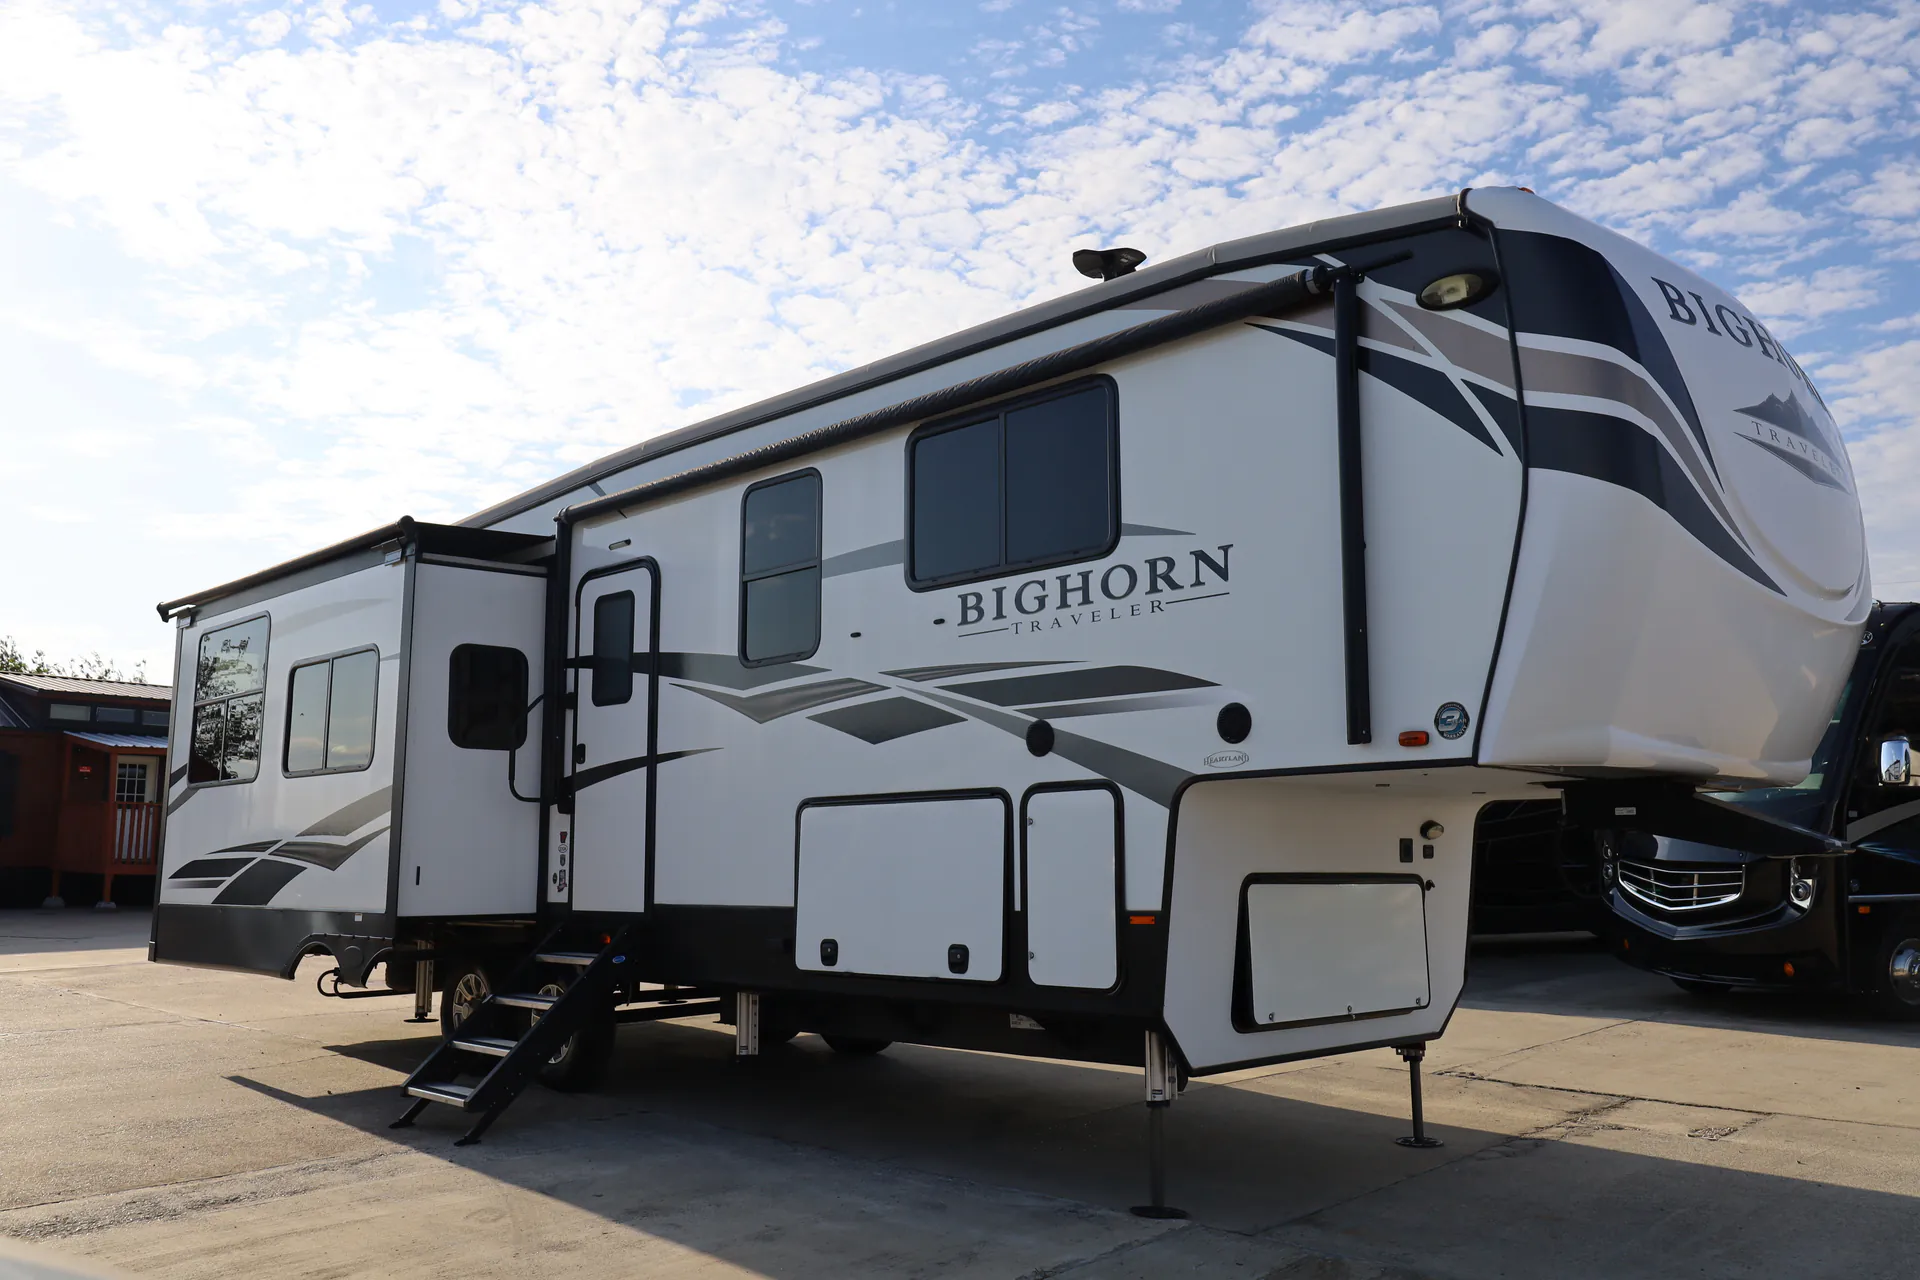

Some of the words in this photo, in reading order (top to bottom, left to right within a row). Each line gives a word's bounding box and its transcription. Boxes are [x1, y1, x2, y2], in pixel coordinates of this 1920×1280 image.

[957, 543, 1234, 626] BIGHORN
[1011, 599, 1164, 635] TRAVELER
[1438, 711, 1460, 731] 3
[1203, 752, 1249, 766] HEARTLAND
